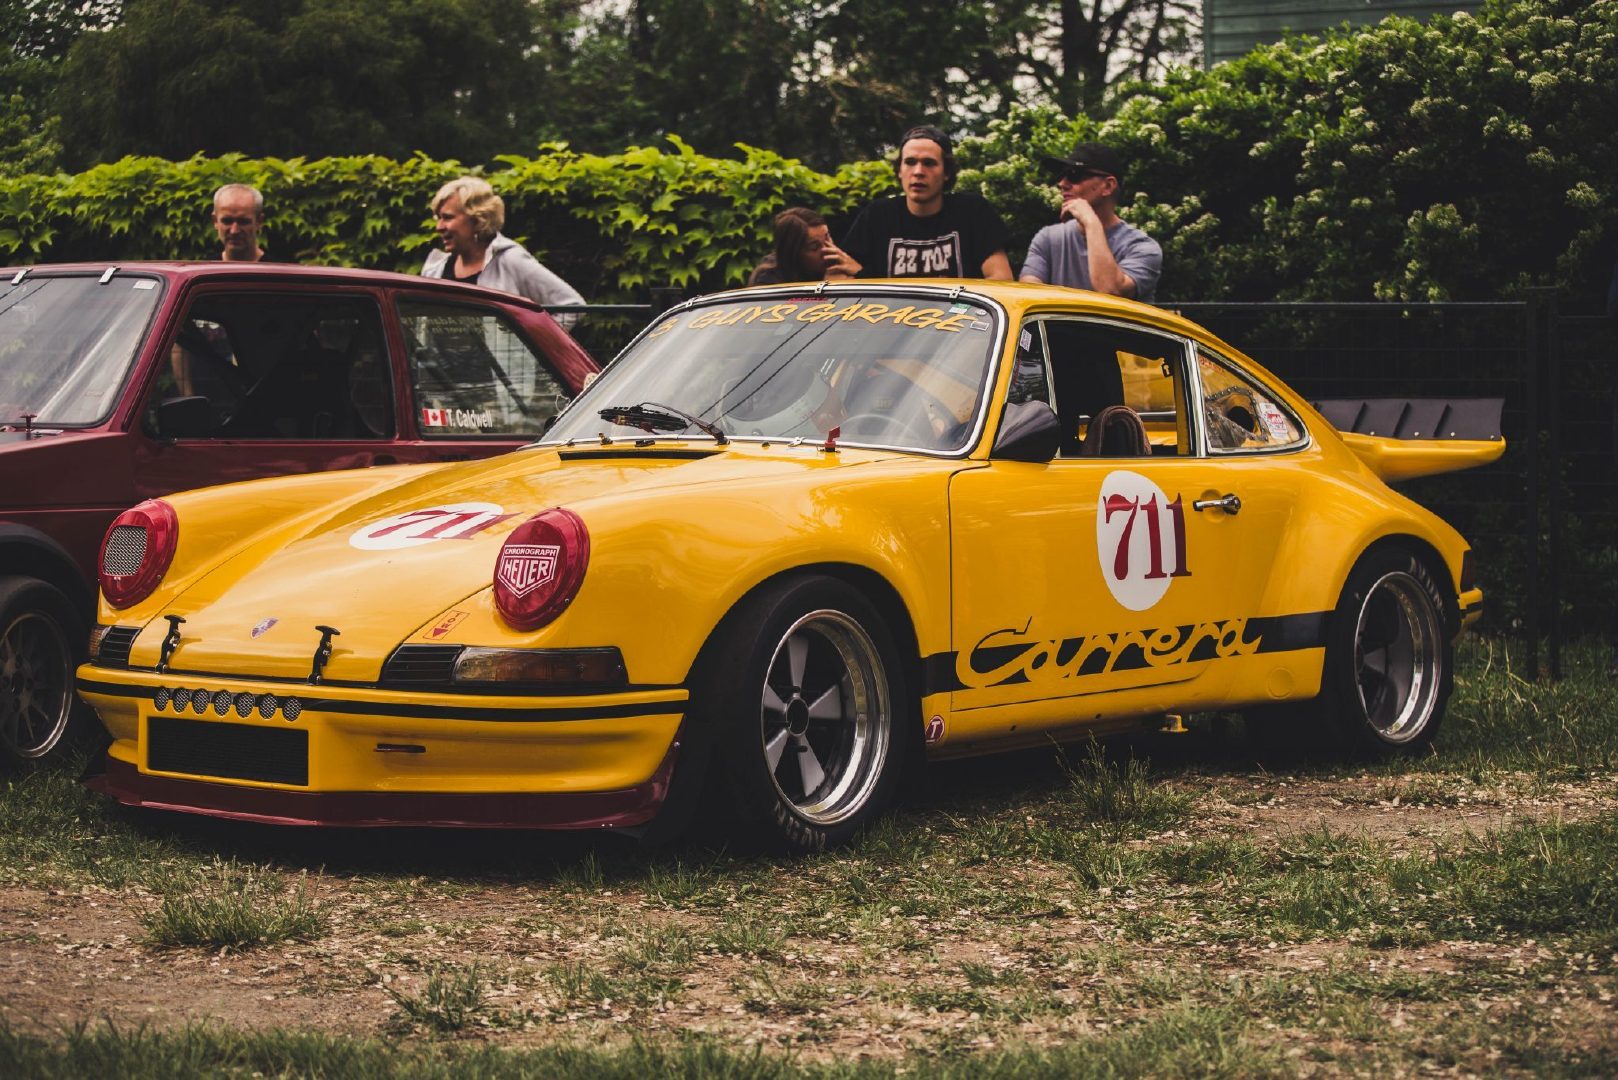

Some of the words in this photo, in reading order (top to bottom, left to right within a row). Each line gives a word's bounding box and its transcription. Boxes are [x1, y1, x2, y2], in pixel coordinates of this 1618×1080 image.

[894, 247, 917, 275] ZZ
[921, 243, 952, 273] TOP
[688, 304, 798, 329] GUYS
[796, 303, 977, 333] GARAGE
[456, 408, 493, 428] Caldwell
[367, 510, 524, 540] 711
[1102, 492, 1192, 581] 711
[504, 548, 556, 556] CHRONOGRAPH
[503, 559, 550, 589] HEUER
[956, 616, 1262, 689] Carrera
